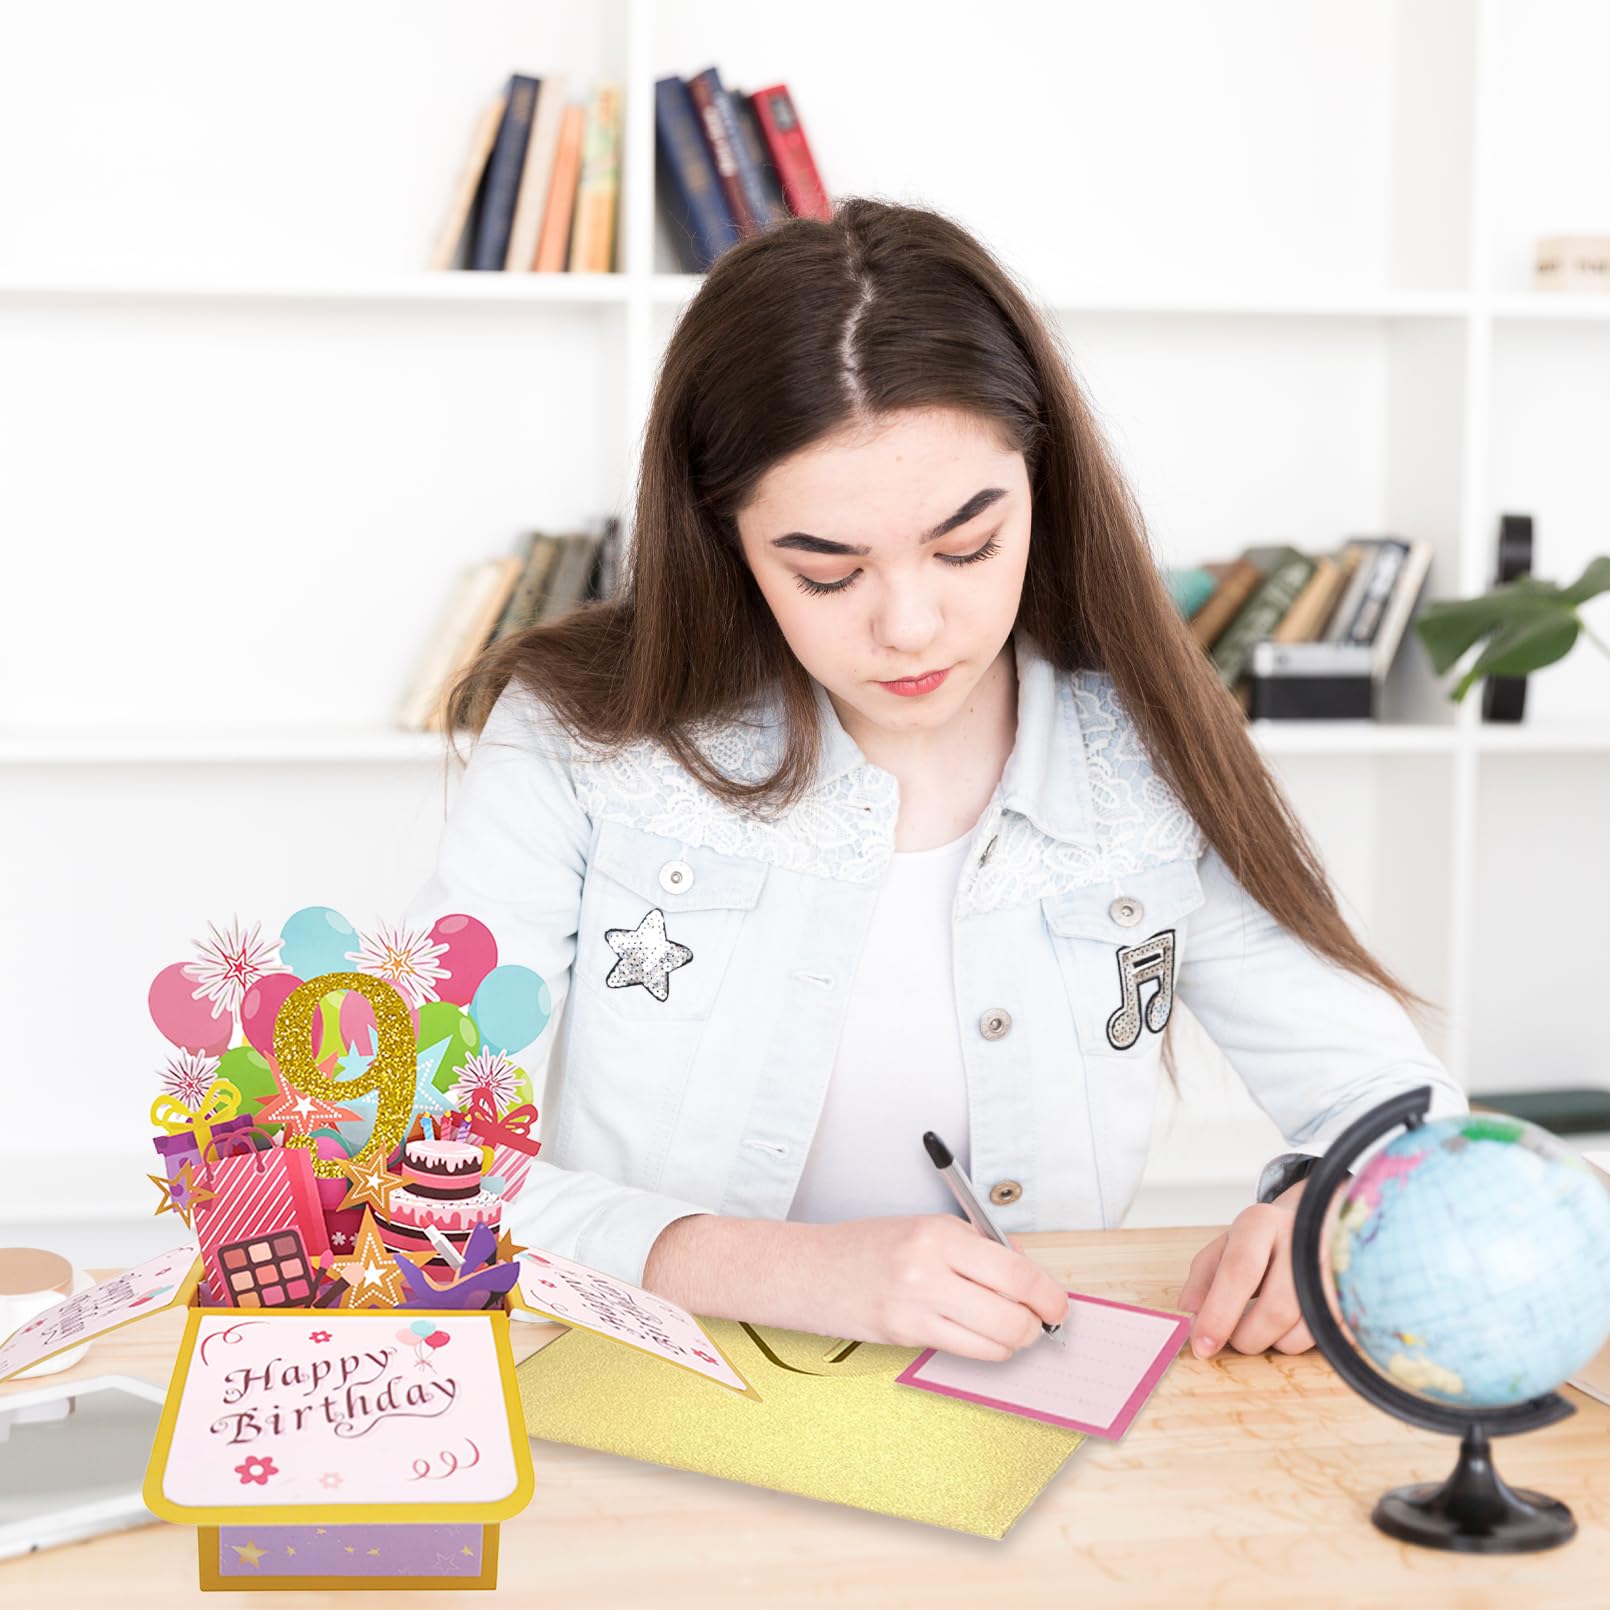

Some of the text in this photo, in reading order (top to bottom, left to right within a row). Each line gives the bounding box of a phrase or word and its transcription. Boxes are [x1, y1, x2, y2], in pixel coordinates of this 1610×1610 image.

[273, 971, 417, 1178] 9
[209, 1375, 456, 1446] Birthday
[222, 1346, 397, 1404] Happy
